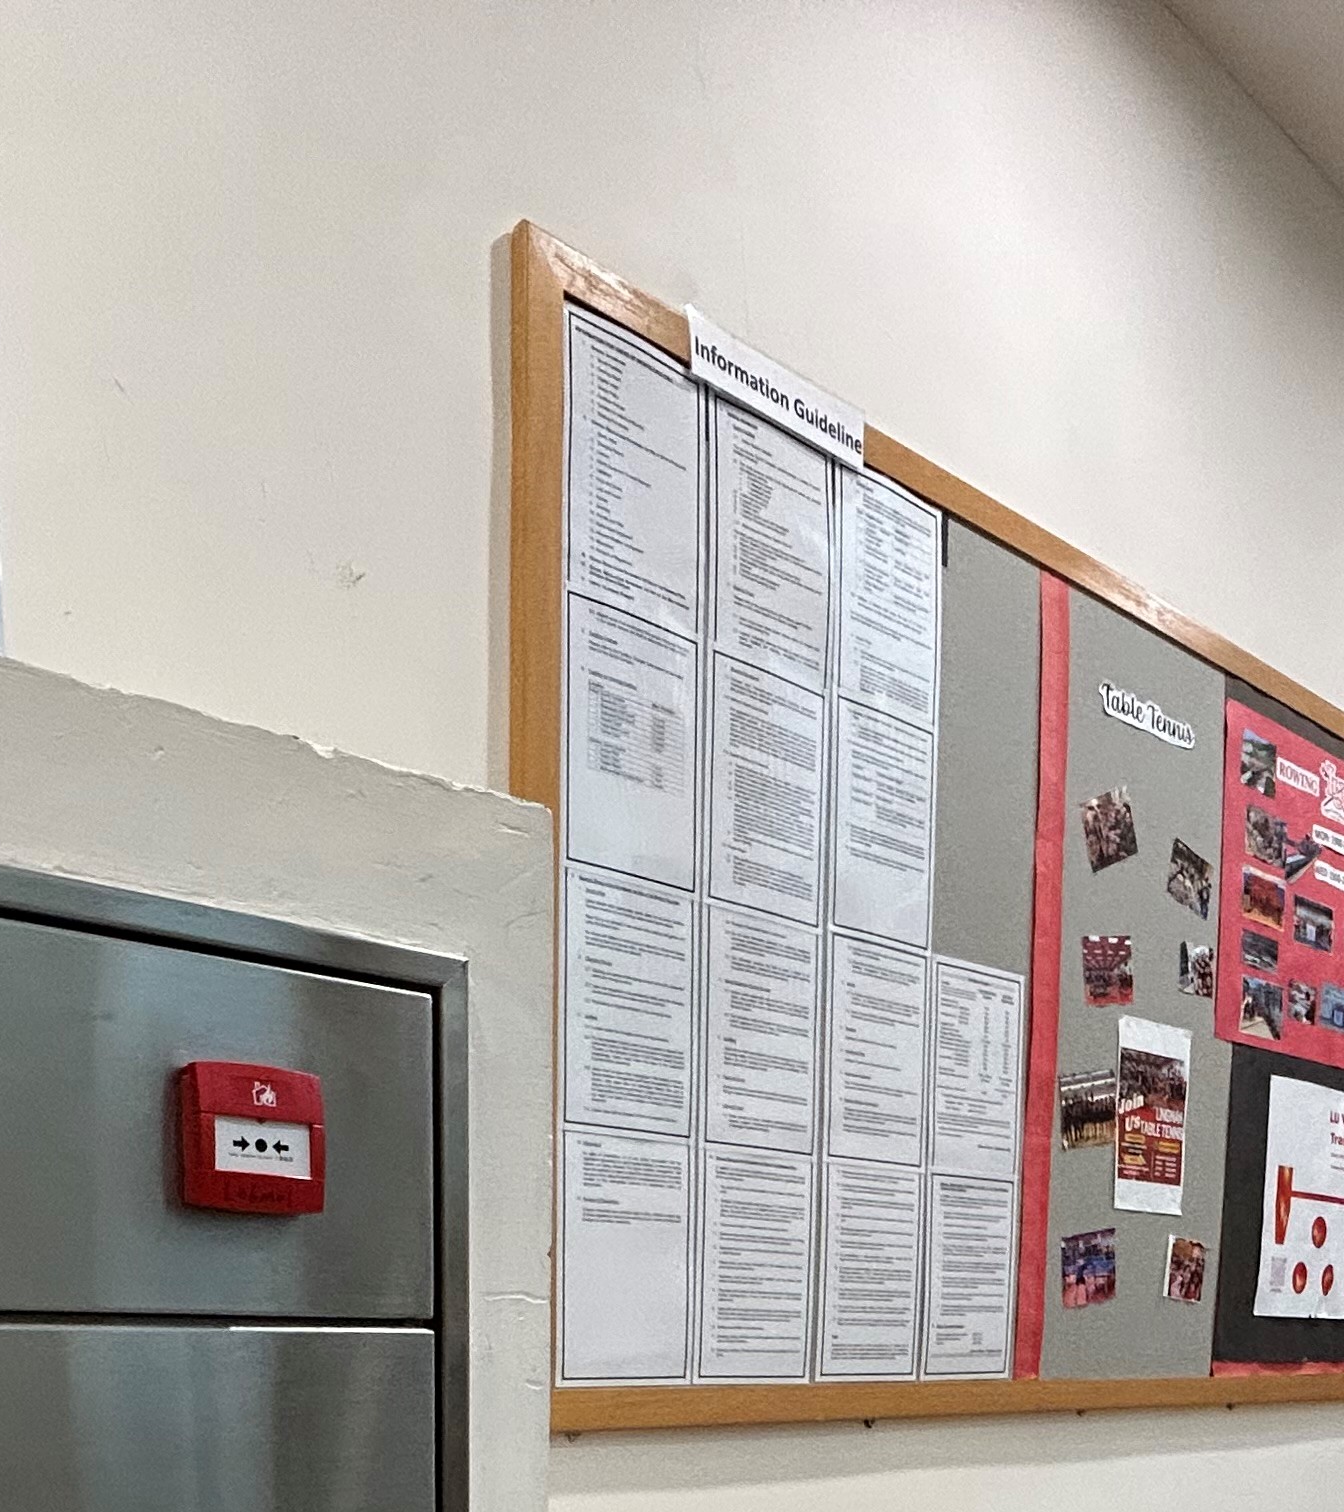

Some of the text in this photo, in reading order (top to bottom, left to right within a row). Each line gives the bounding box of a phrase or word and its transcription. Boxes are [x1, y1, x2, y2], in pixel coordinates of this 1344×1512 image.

[695, 335, 863, 455] Information Guideline
[1101, 683, 1195, 745] Table Tennis
